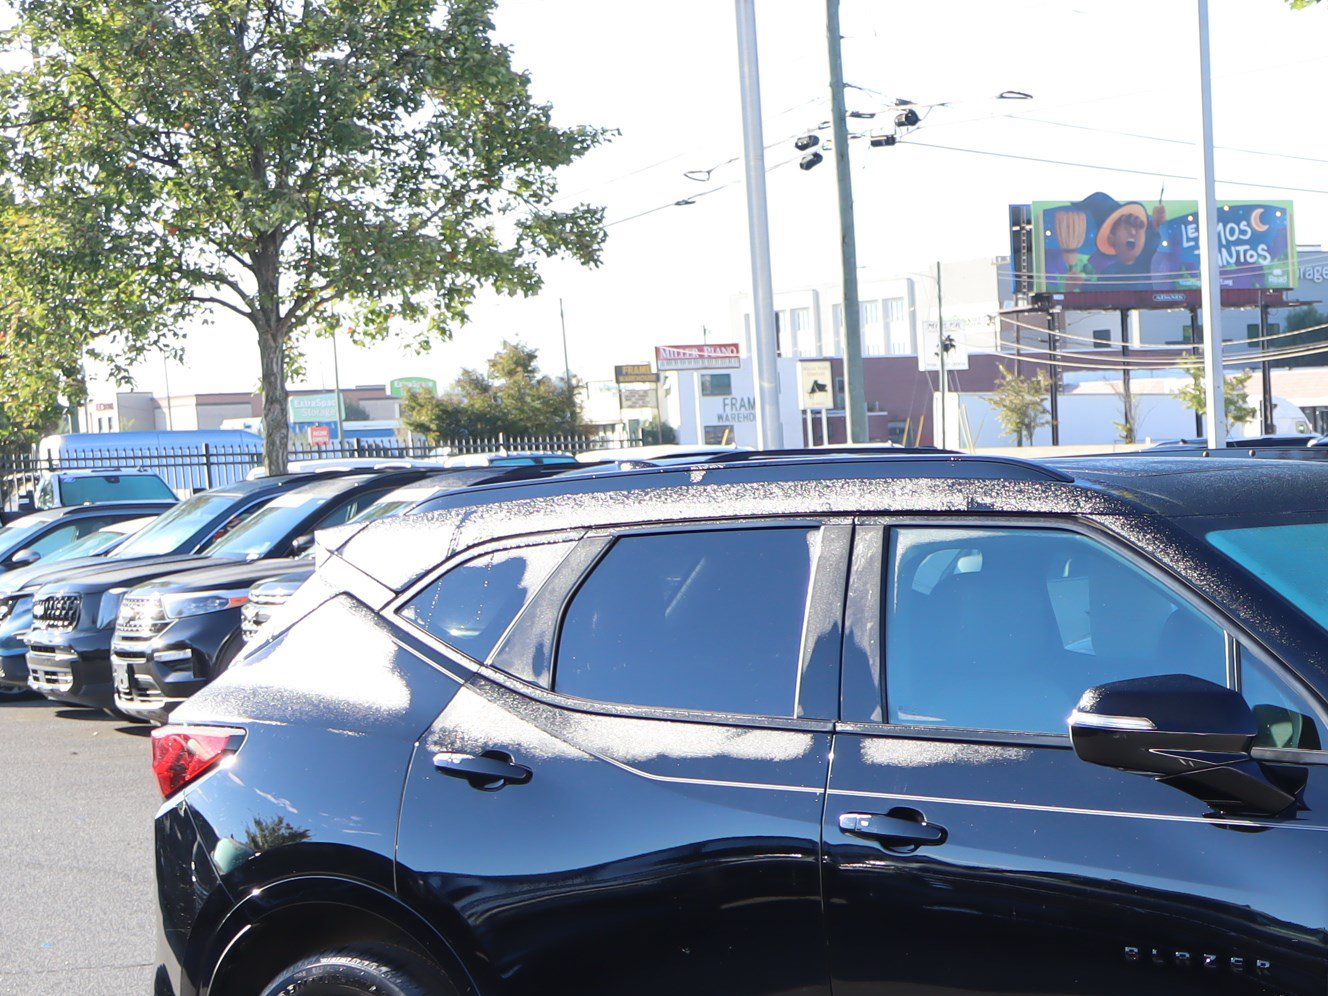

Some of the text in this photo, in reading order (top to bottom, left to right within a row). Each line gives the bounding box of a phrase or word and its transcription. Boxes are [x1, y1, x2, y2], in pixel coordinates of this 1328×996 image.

[1181, 221, 1252, 248] LEMOS
[1194, 244, 1272, 266] NTOS
[661, 346, 737, 359] MILLER PIANO
[295, 398, 336, 408] ExtraSpac
[723, 397, 755, 412] FRAM
[717, 412, 756, 423] WAREHO
[1124, 946, 1271, 975] BLAZER
